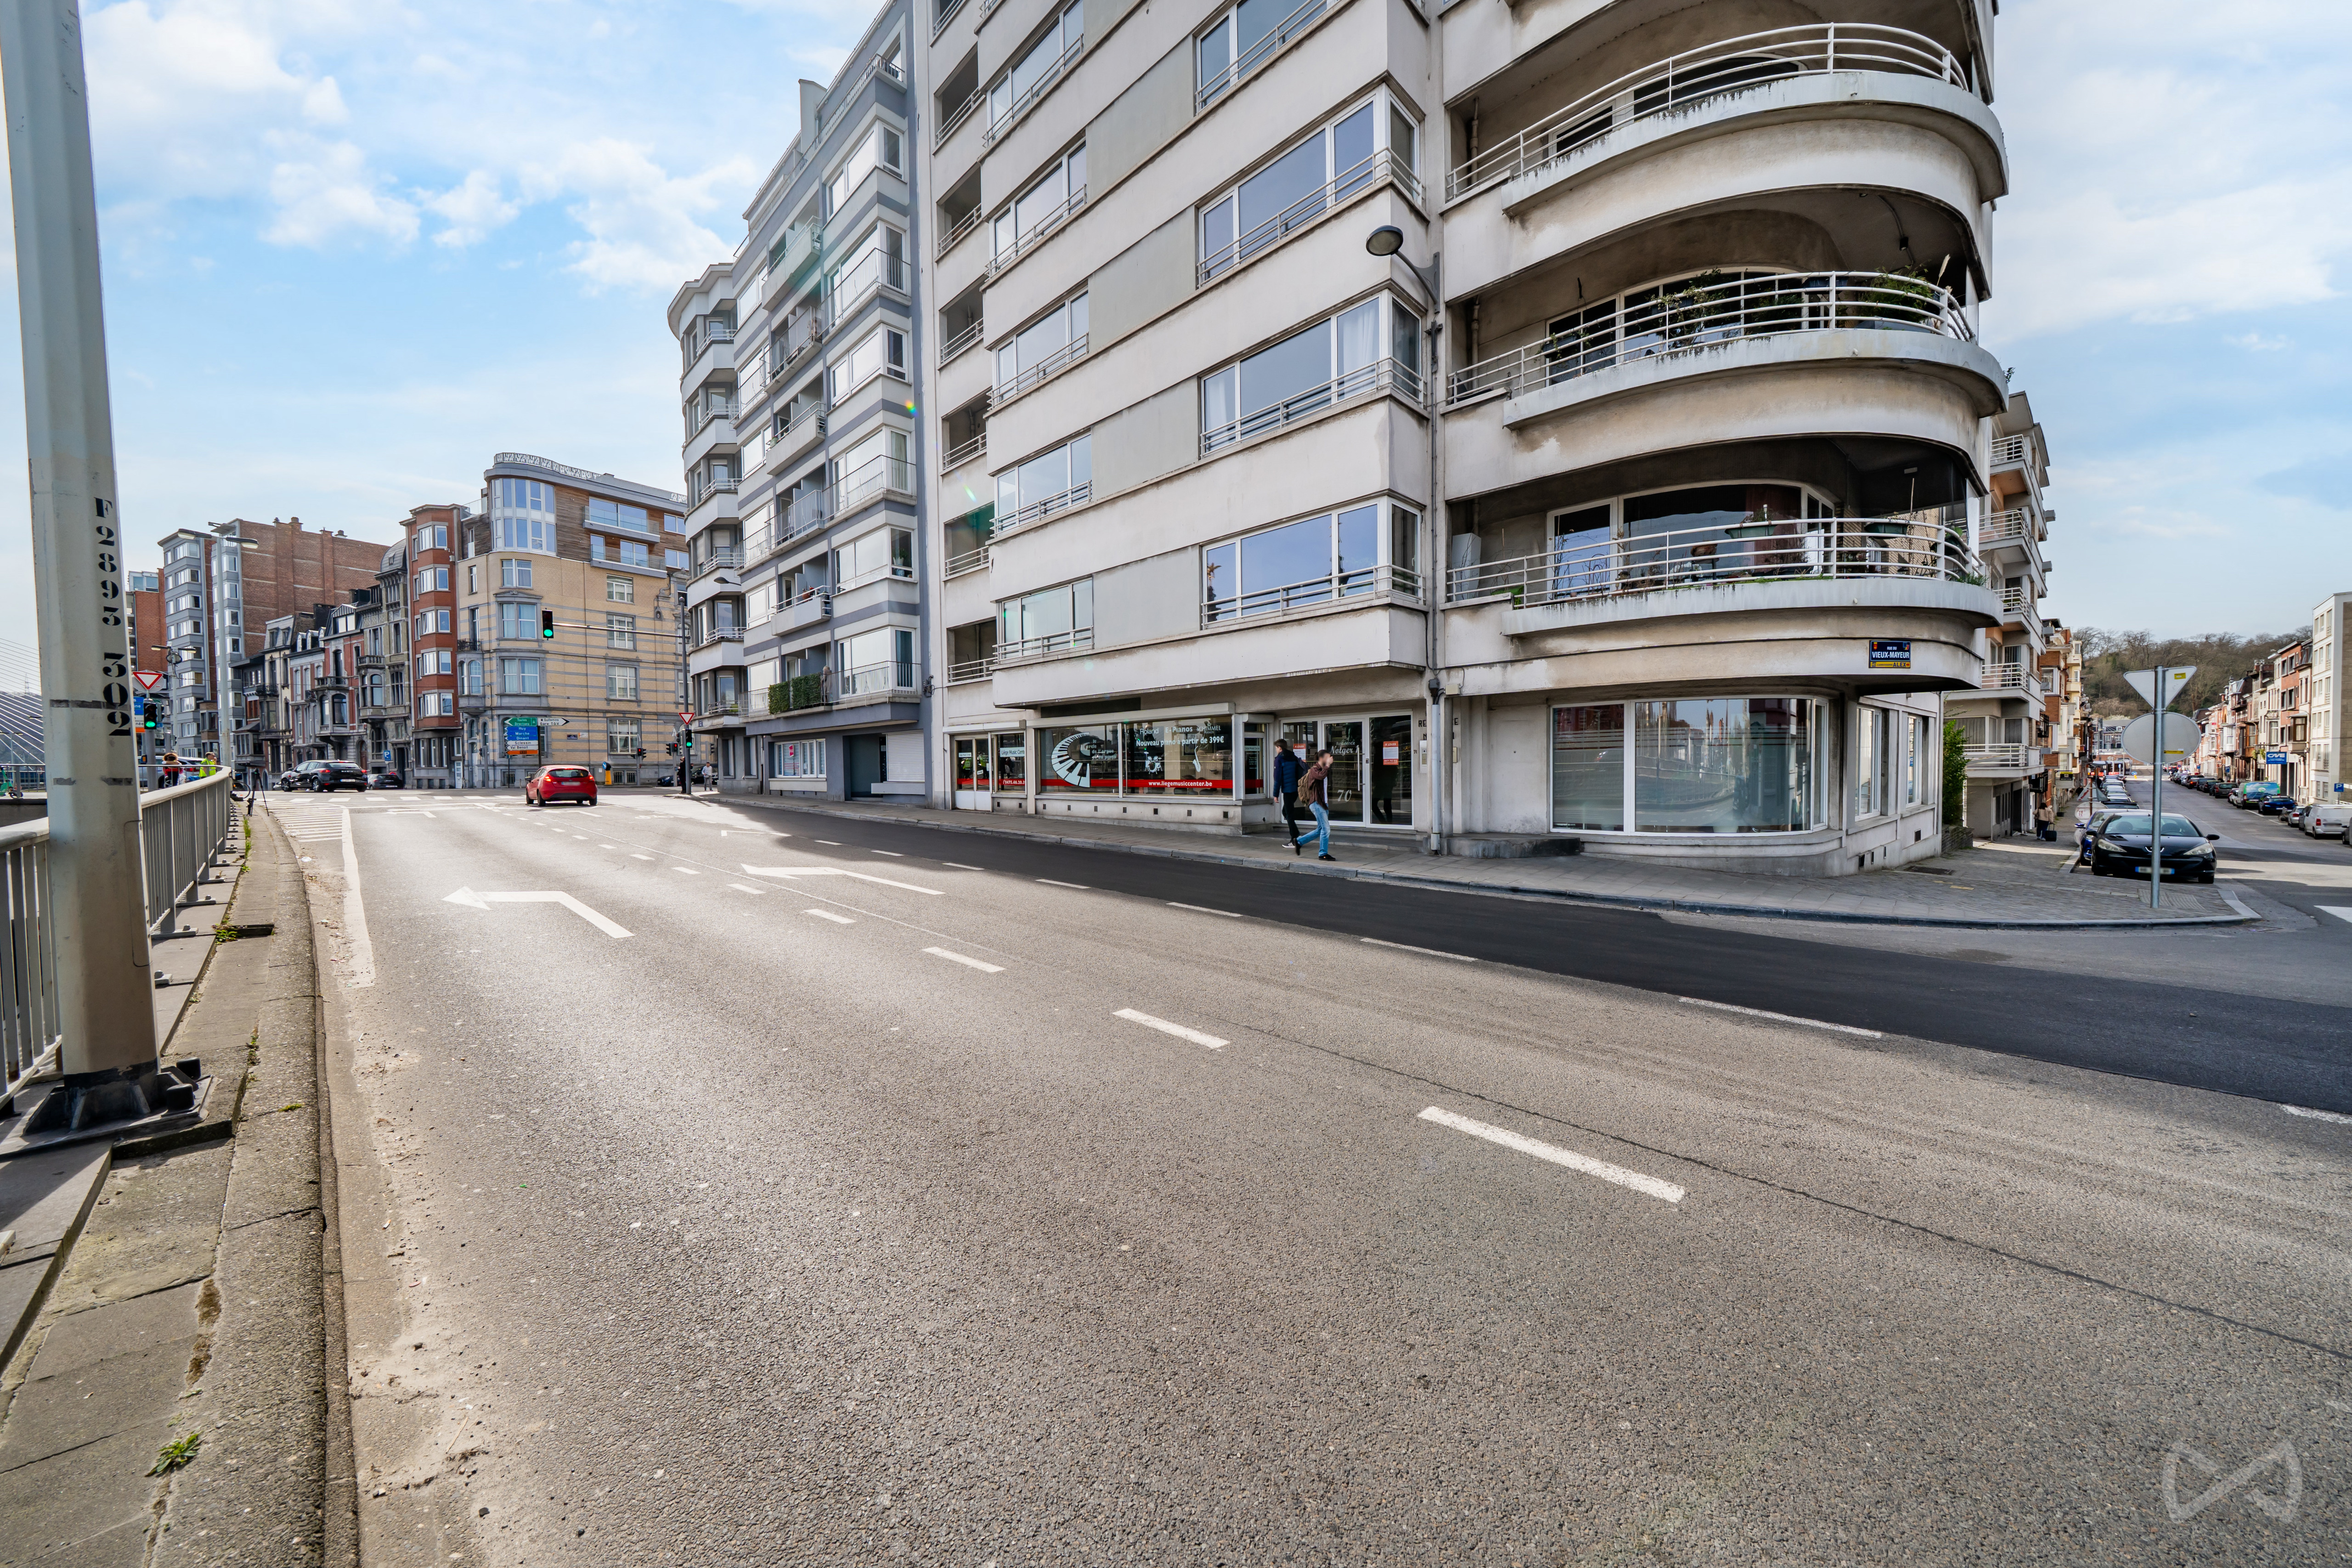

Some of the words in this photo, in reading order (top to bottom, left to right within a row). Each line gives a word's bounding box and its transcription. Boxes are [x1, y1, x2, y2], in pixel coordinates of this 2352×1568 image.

[1182, 738, 1199, 746] partir
[1330, 746, 1353, 756] Notger
[1337, 790, 1352, 802] 70
